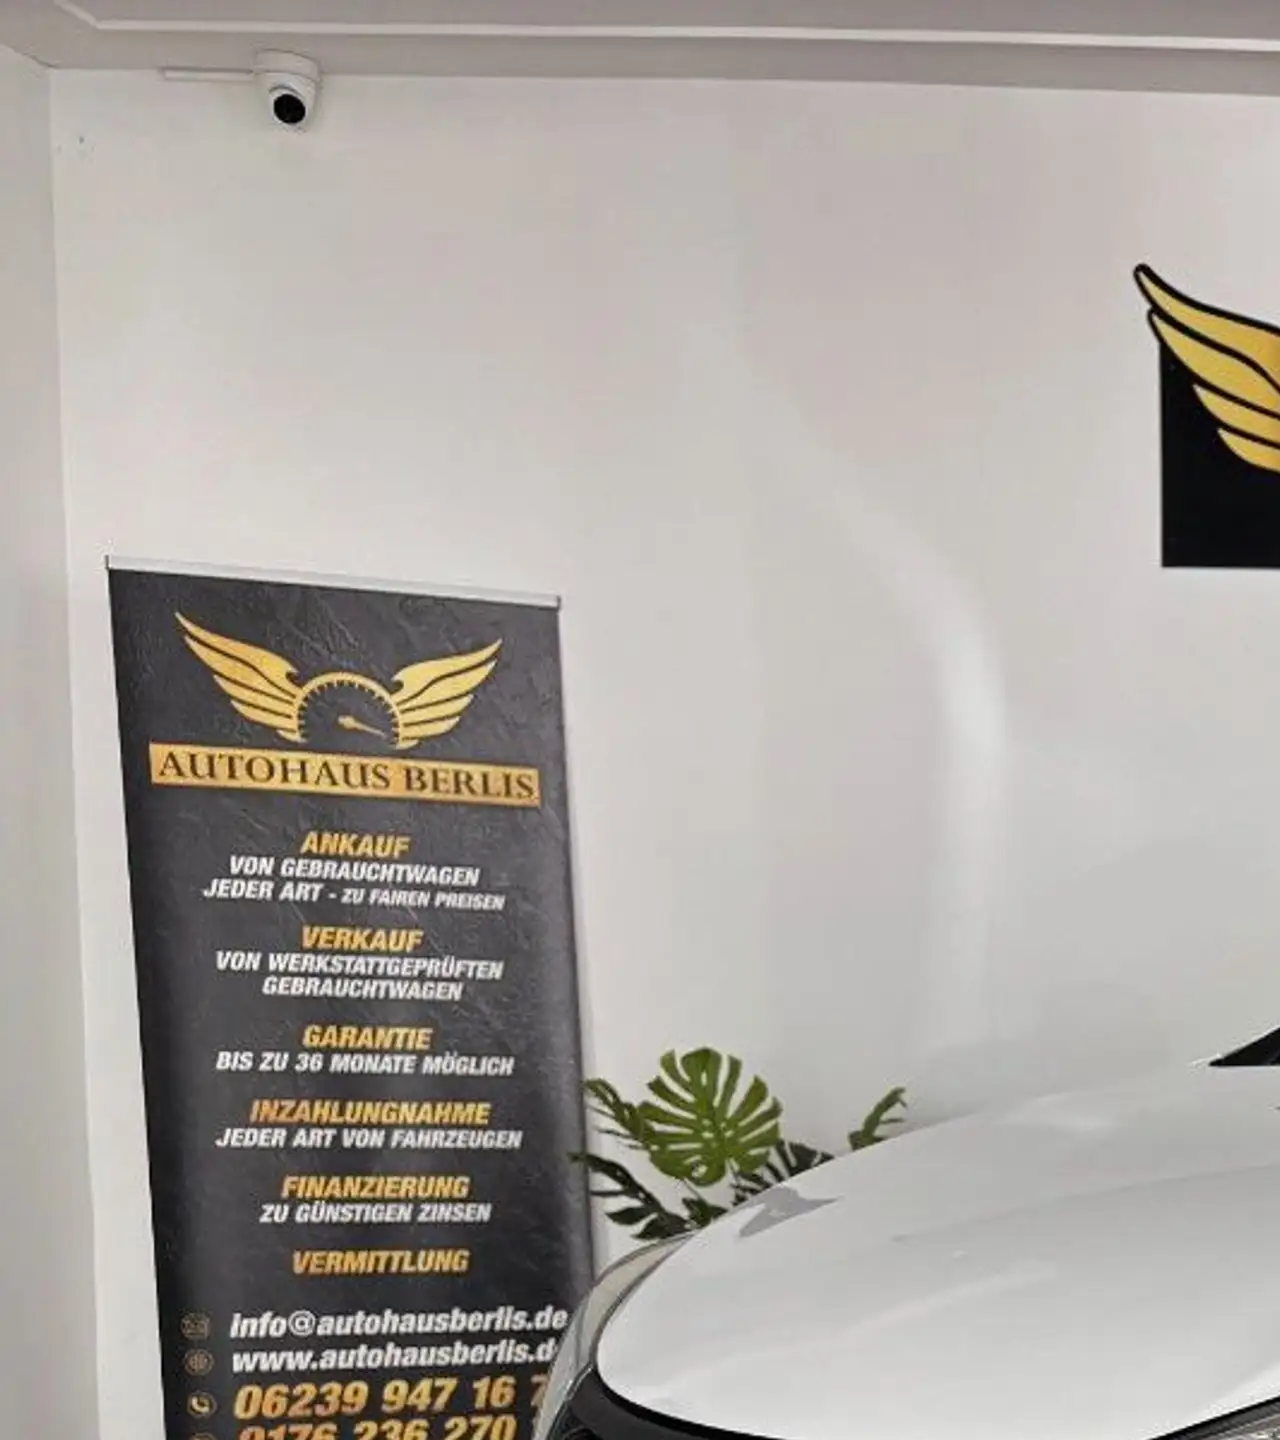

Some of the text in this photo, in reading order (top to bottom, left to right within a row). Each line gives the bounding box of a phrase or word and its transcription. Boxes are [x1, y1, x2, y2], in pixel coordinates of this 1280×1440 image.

[158, 751, 536, 800] AUTOHAUS BERLIS
[301, 831, 411, 859] ANKAUF
[229, 856, 480, 887] VON GEBRAUCHTWAGEN
[203, 879, 274, 899] JEDER
[279, 882, 323, 903] ART
[341, 887, 365, 904] ZU
[369, 889, 430, 907] FAIREN
[434, 892, 505, 911] PREISEN
[302, 925, 423, 952] VERKAUF
[216, 951, 504, 980] VON WERKSTATTGEPRÜFTEN
[262, 976, 464, 1000] GEBRAUCHTWAGEN
[303, 1025, 434, 1050] GARANTIE
[216, 1050, 516, 1076] BIS ZU 36 MONATE MÖGLICH
[250, 1099, 492, 1125] INZAHLUNGNAHME
[215, 1128, 523, 1149] JEDER ART VON FAHRZEUGEN
[281, 1175, 472, 1199] FINANZIERUNG
[259, 1199, 493, 1223] ZU GÜNSTIGEN ZINSEN
[292, 1250, 472, 1275] VERMITTLUNG
[230, 1305, 568, 1338] info@autohausberlis.de
[232, 1338, 557, 1373] www.autohausberlis.d
[233, 1380, 370, 1420] 06239
[381, 1377, 458, 1414] 947
[472, 1375, 517, 1409] 16
